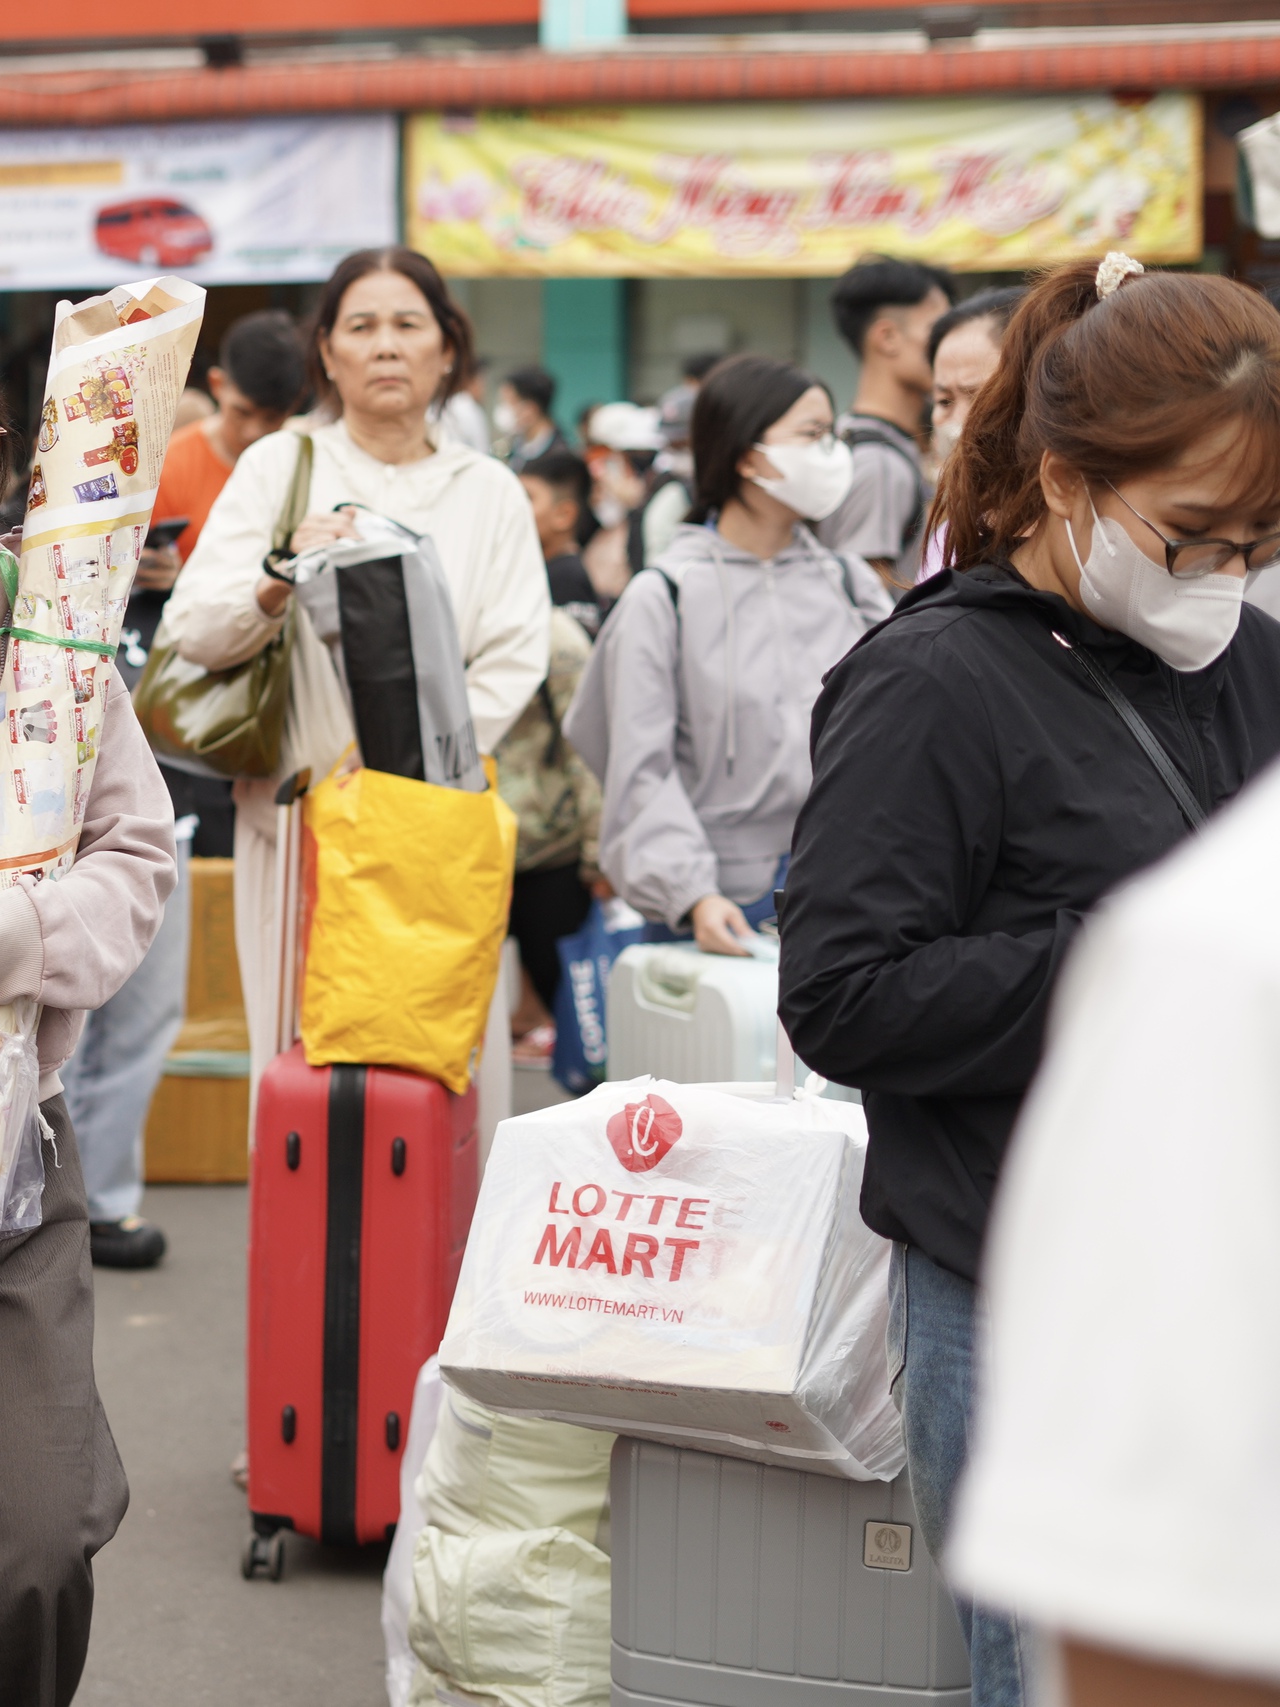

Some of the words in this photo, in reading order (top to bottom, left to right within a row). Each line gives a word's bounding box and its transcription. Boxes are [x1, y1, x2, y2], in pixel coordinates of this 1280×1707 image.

[548, 1181, 710, 1230] LOTTE
[532, 1224, 701, 1282] MART
[523, 1290, 684, 1324] WWW.LOTTEMART.VN
